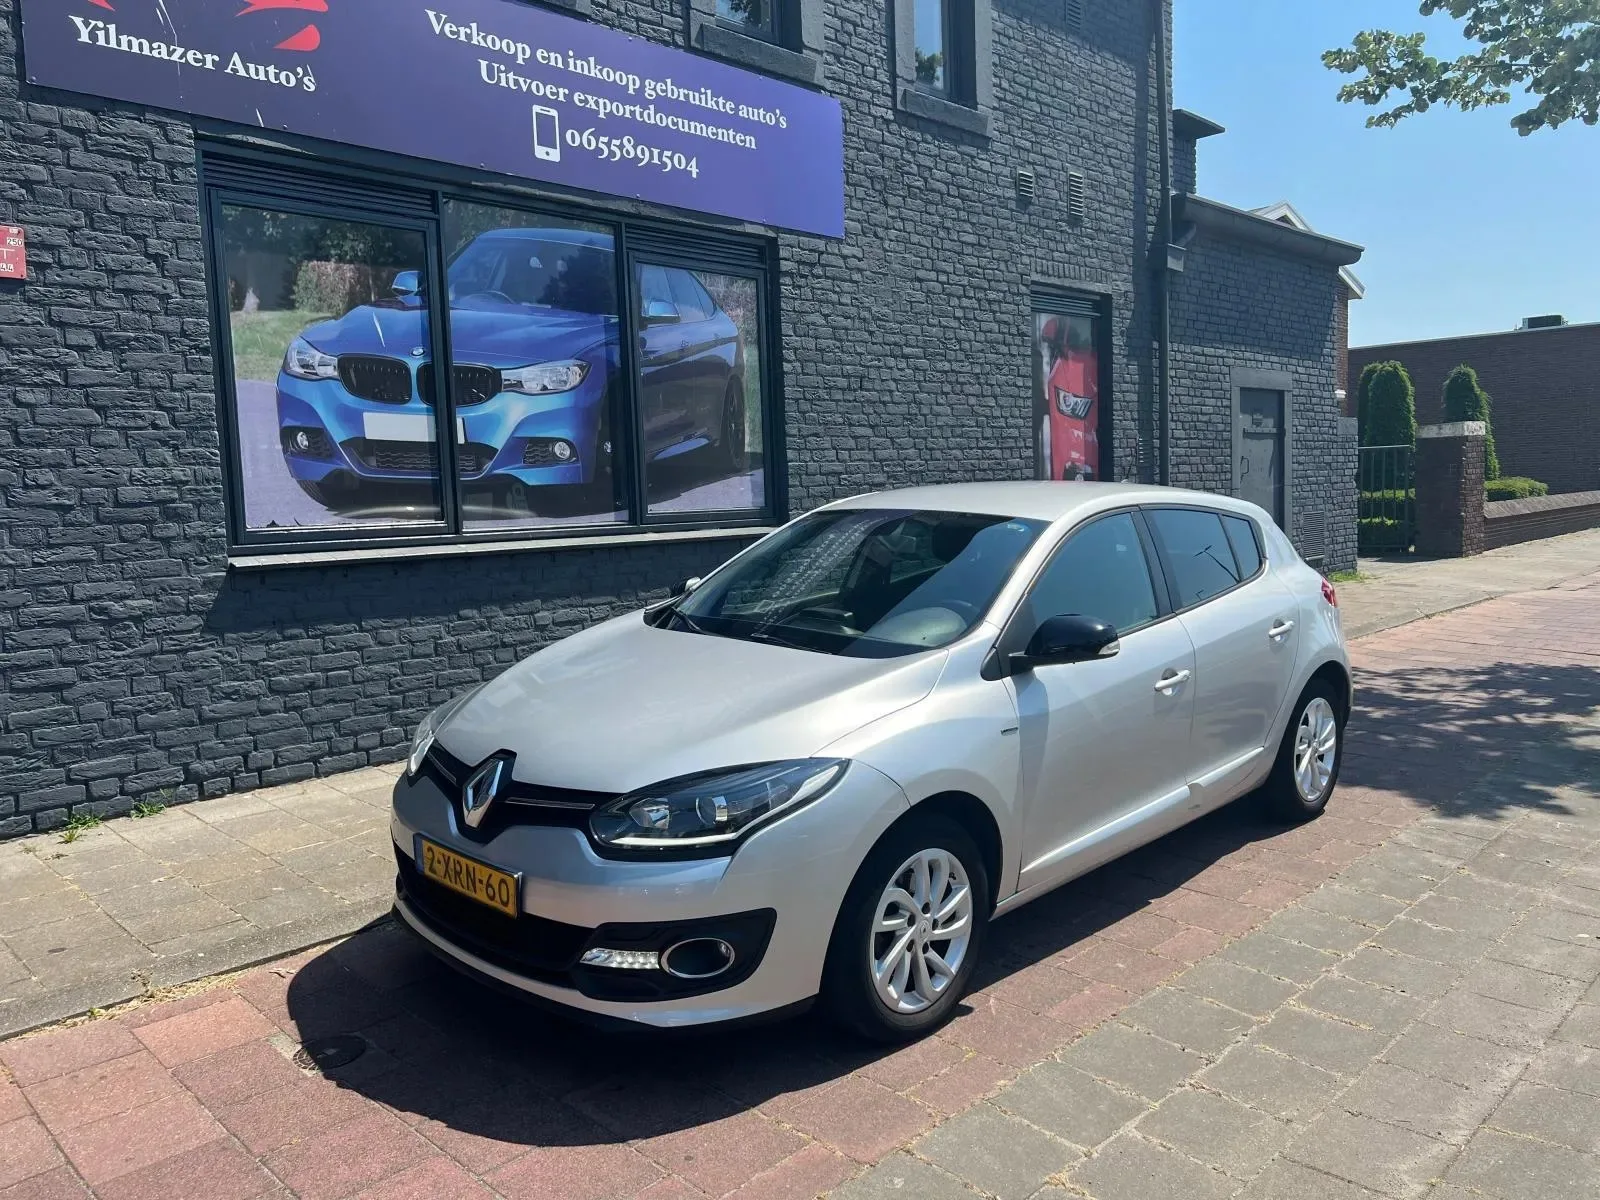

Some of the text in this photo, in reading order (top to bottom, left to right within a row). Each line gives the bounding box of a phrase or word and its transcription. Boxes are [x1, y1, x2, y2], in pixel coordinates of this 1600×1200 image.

[68, 15, 317, 92] Yilmazer Auto's
[425, 9, 788, 129] Verkoop en inkoop gebruikte auto's
[477, 59, 757, 150] Uitvoer exportdocumenten
[565, 128, 700, 179] 0655891504
[7, 238, 23, 246] 250
[424, 844, 511, 909] 2-XRN-60
